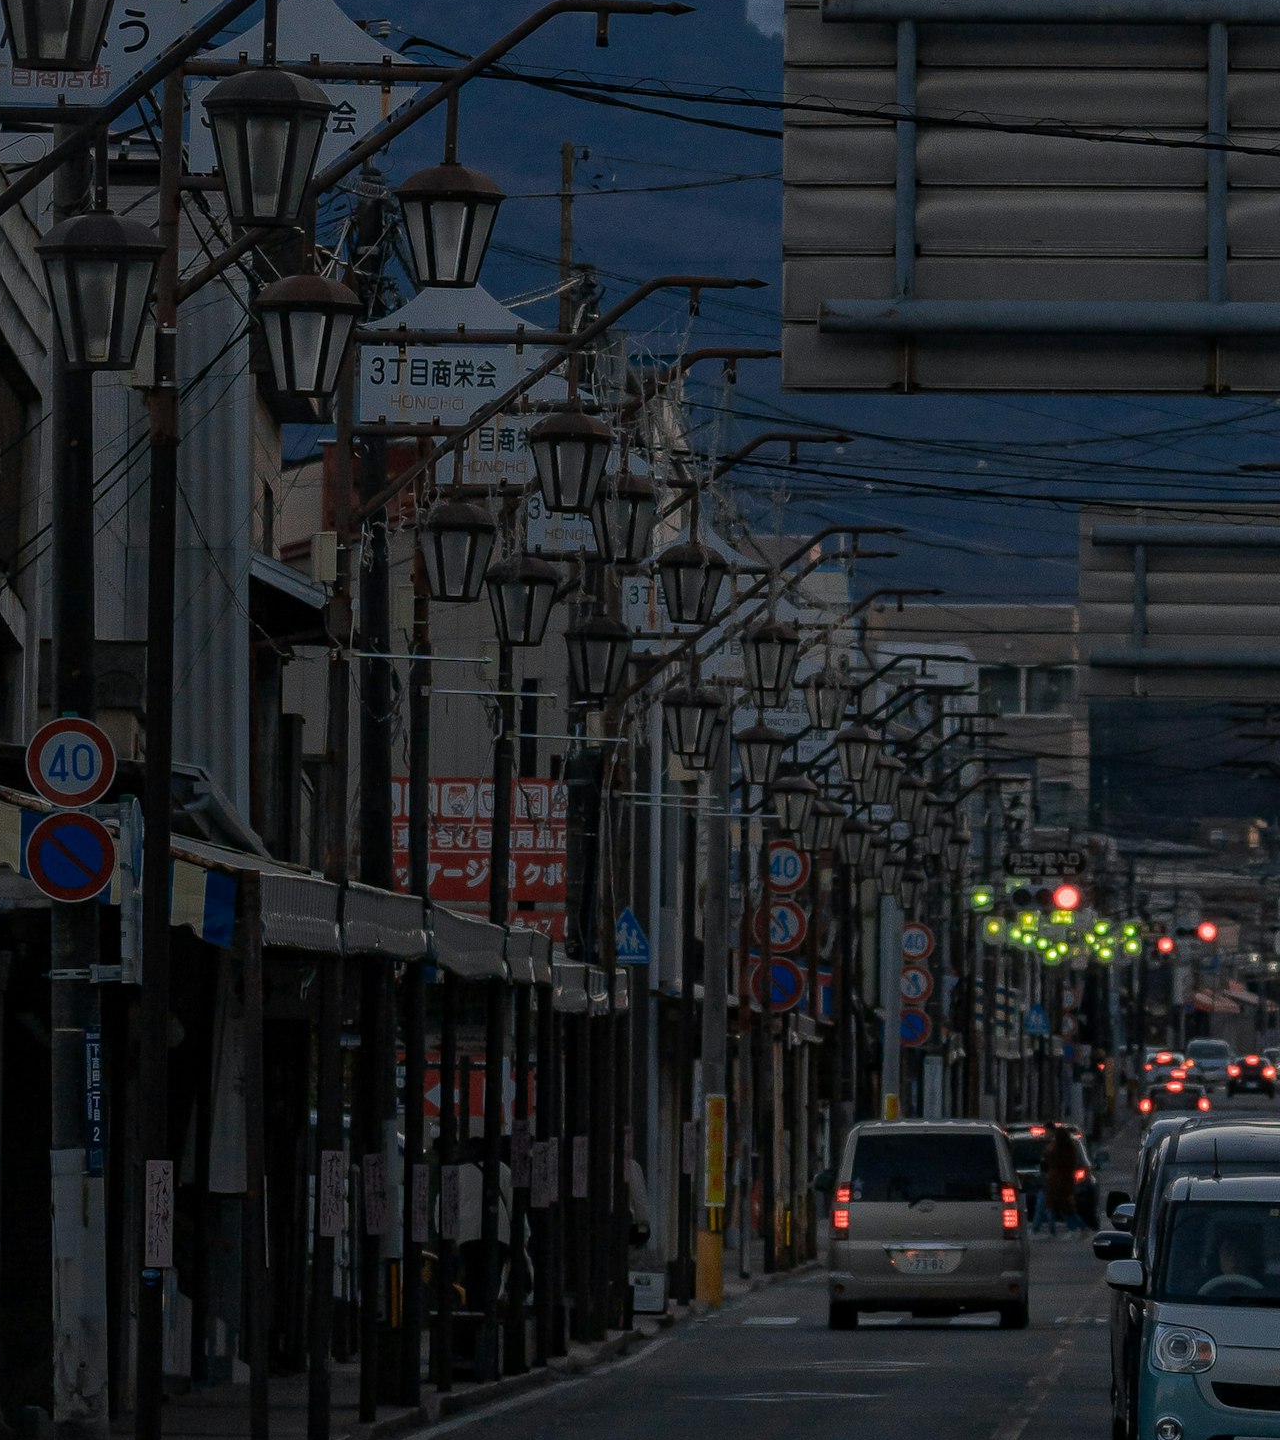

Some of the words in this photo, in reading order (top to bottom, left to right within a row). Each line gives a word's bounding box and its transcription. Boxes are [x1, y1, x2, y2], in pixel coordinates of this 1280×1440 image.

[369, 356, 497, 388] 3丁目商栄会
[47, 743, 96, 783] 40
[768, 855, 798, 878] 40
[93, 1127, 100, 1142] 2
